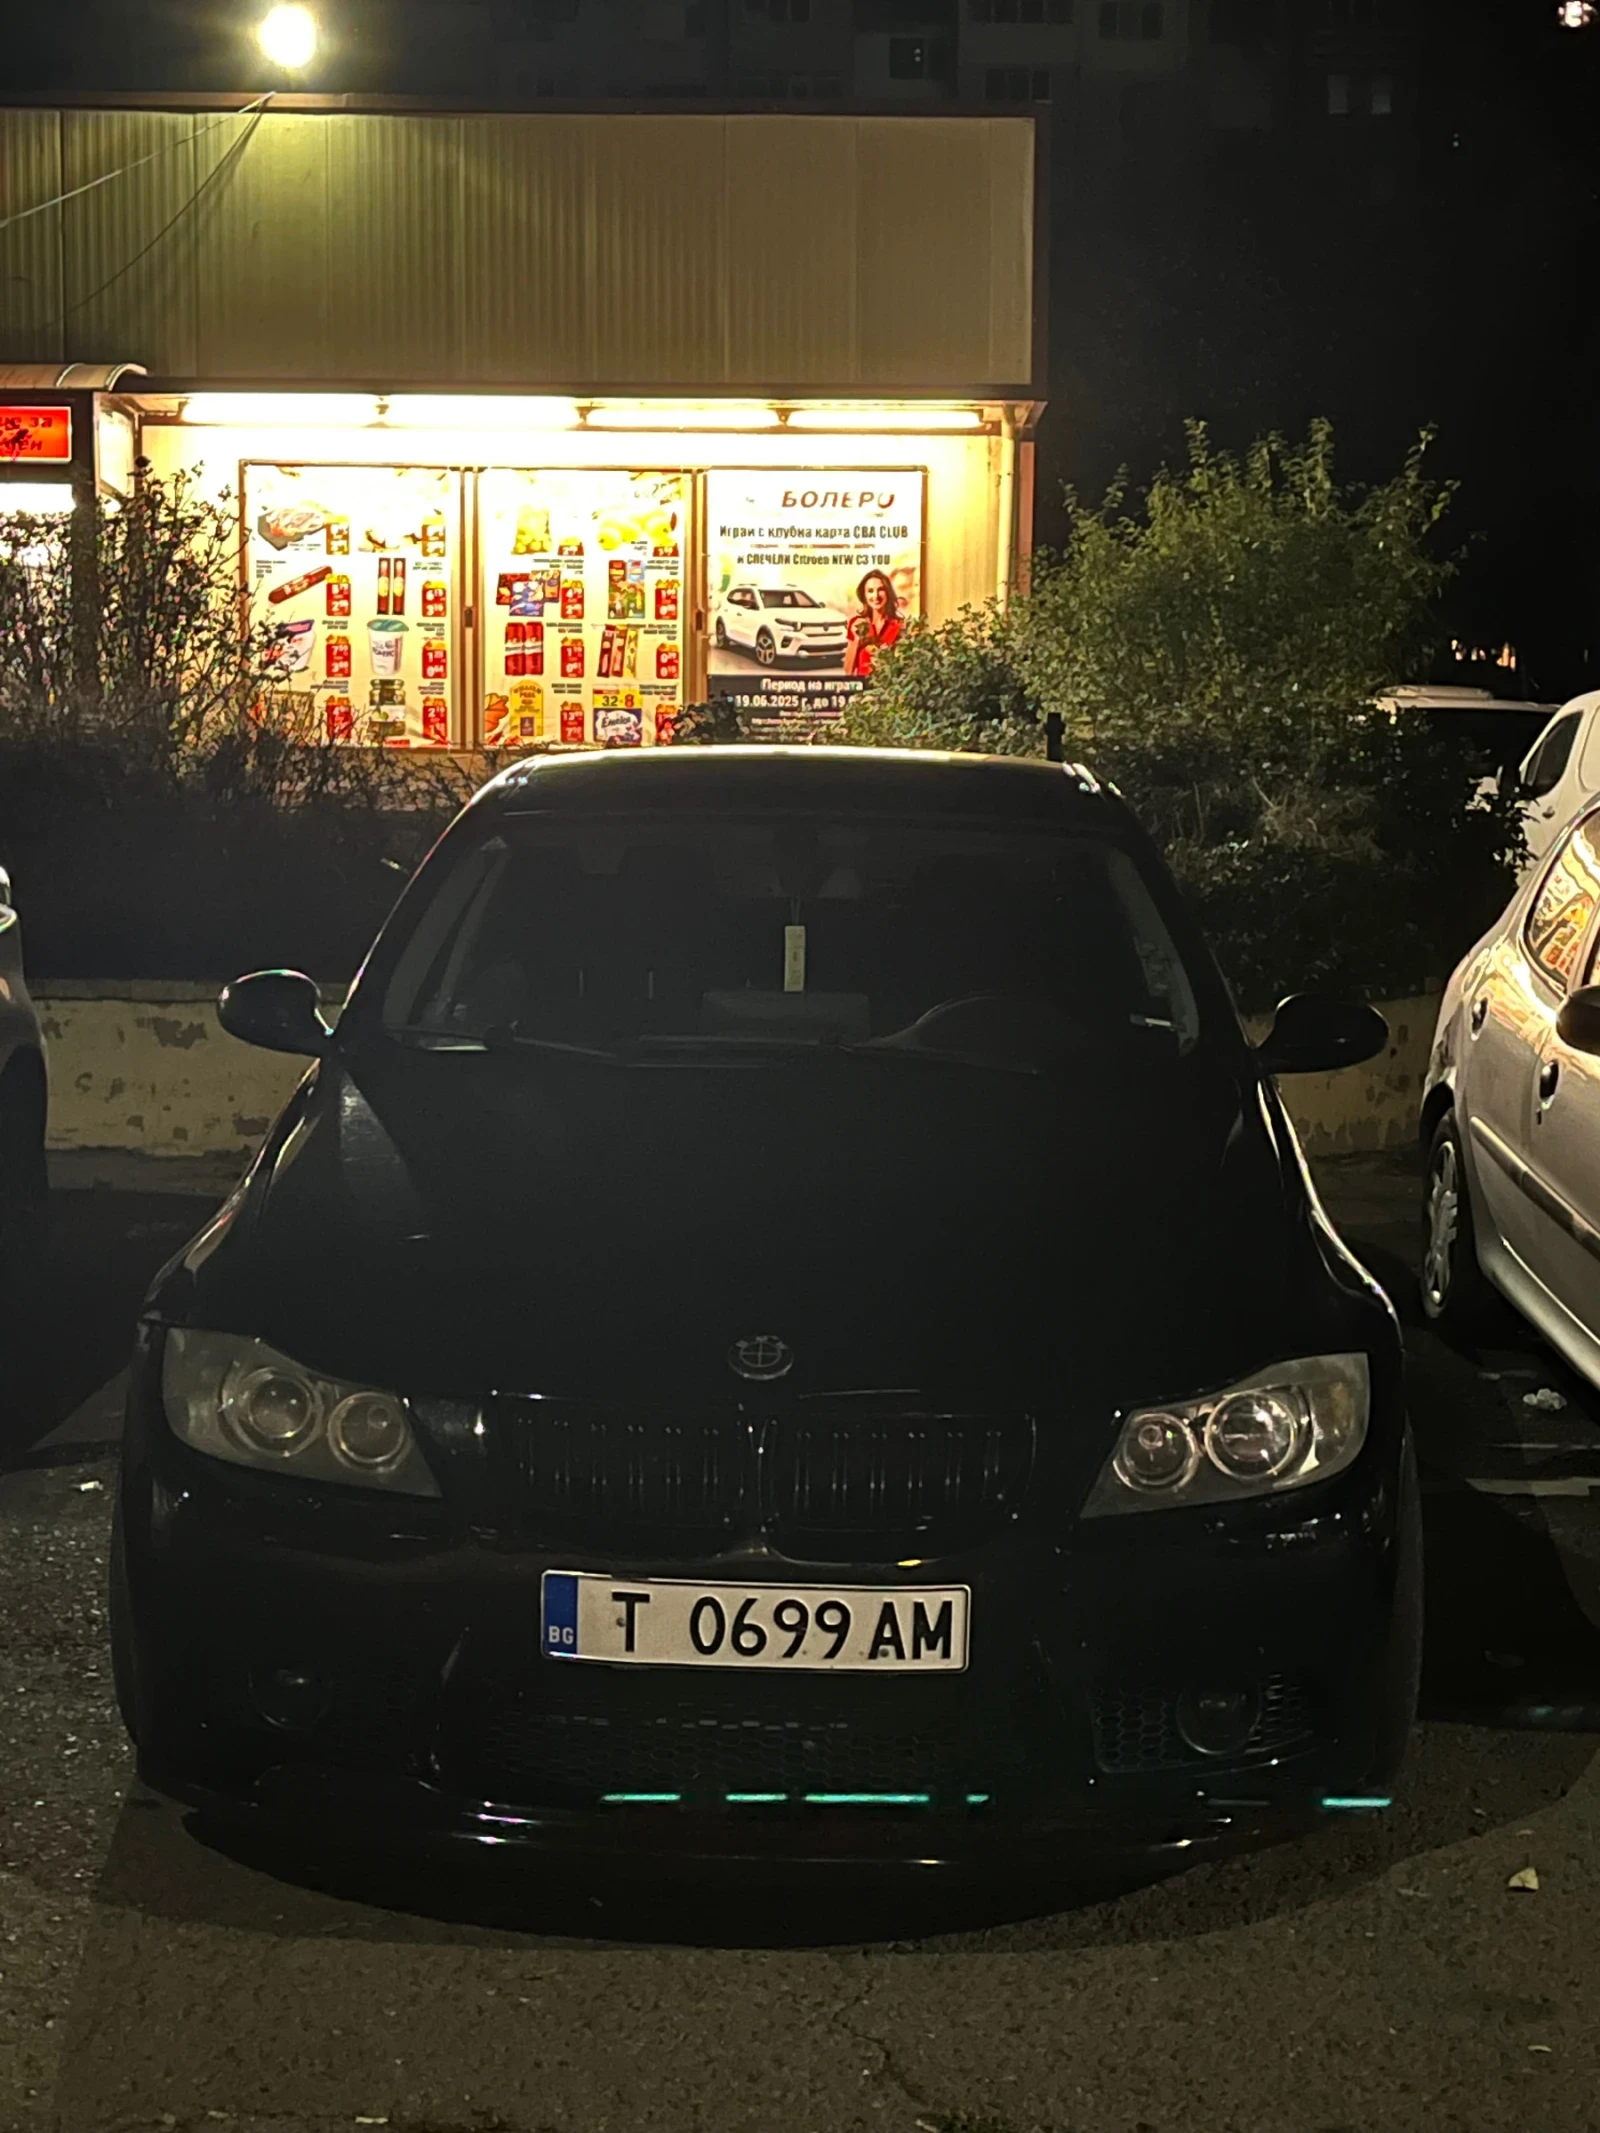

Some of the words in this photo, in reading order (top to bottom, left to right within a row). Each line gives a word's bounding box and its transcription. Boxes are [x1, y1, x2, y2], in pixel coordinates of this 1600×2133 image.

[781, 490, 895, 509] БОЛЕРО
[768, 525, 812, 539] клубна
[815, 528, 850, 539] карта
[879, 525, 908, 539] CLUB
[746, 553, 790, 565] СПЕЧЕЛИ
[832, 554, 854, 565] NEW
[856, 554, 869, 565] C3
[871, 554, 890, 565] YOU
[760, 678, 806, 693] Период
[807, 681, 822, 691] на
[824, 681, 863, 693] играта
[735, 695, 799, 707] 19.06.2025
[813, 697, 829, 709] до
[611, 1591, 650, 1653] T
[690, 1596, 851, 1659] 0699
[868, 1600, 953, 1661] AM
[548, 1625, 574, 1645] BG
